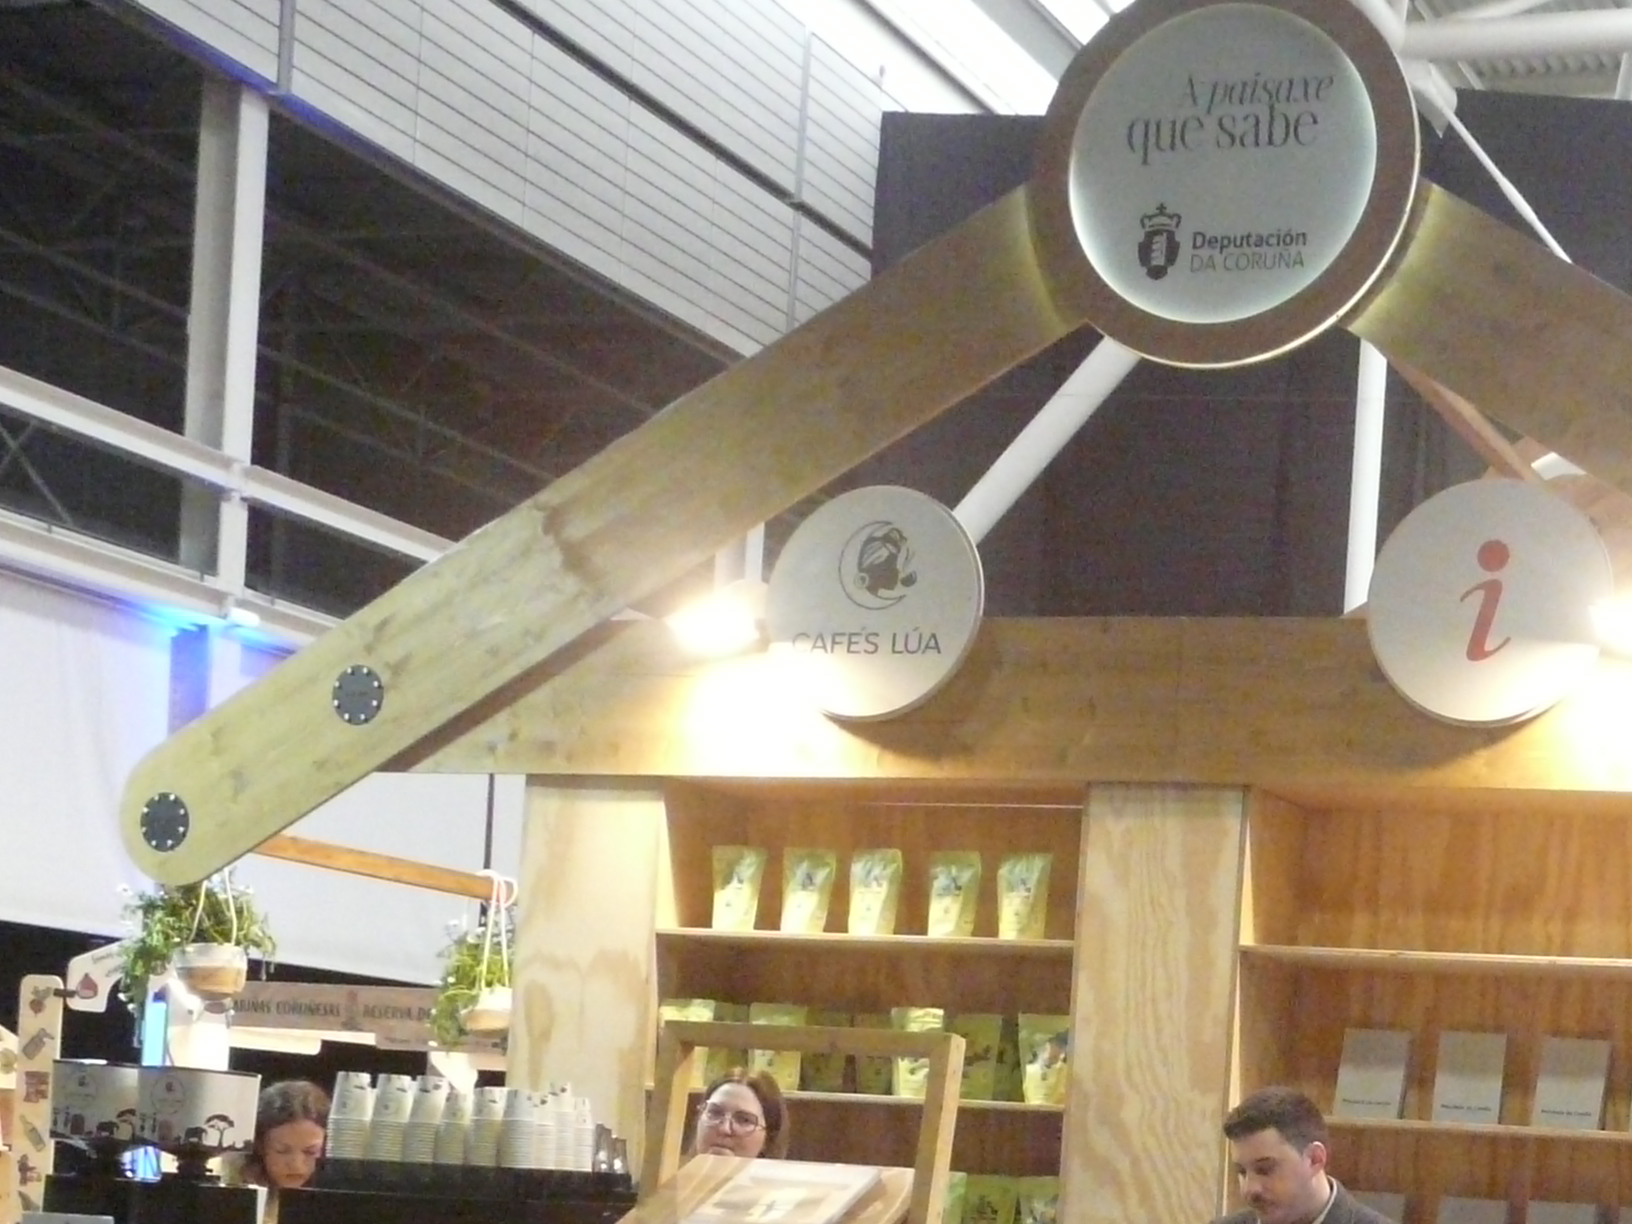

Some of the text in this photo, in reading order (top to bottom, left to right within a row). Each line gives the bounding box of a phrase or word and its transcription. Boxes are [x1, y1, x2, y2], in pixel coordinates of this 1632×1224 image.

[1126, 104, 1320, 166] que sabe
[1191, 229, 1308, 253] Deputación
[1189, 249, 1305, 273] DA CORUÑA
[1459, 539, 1512, 662] i
[891, 626, 942, 655] LÚA
